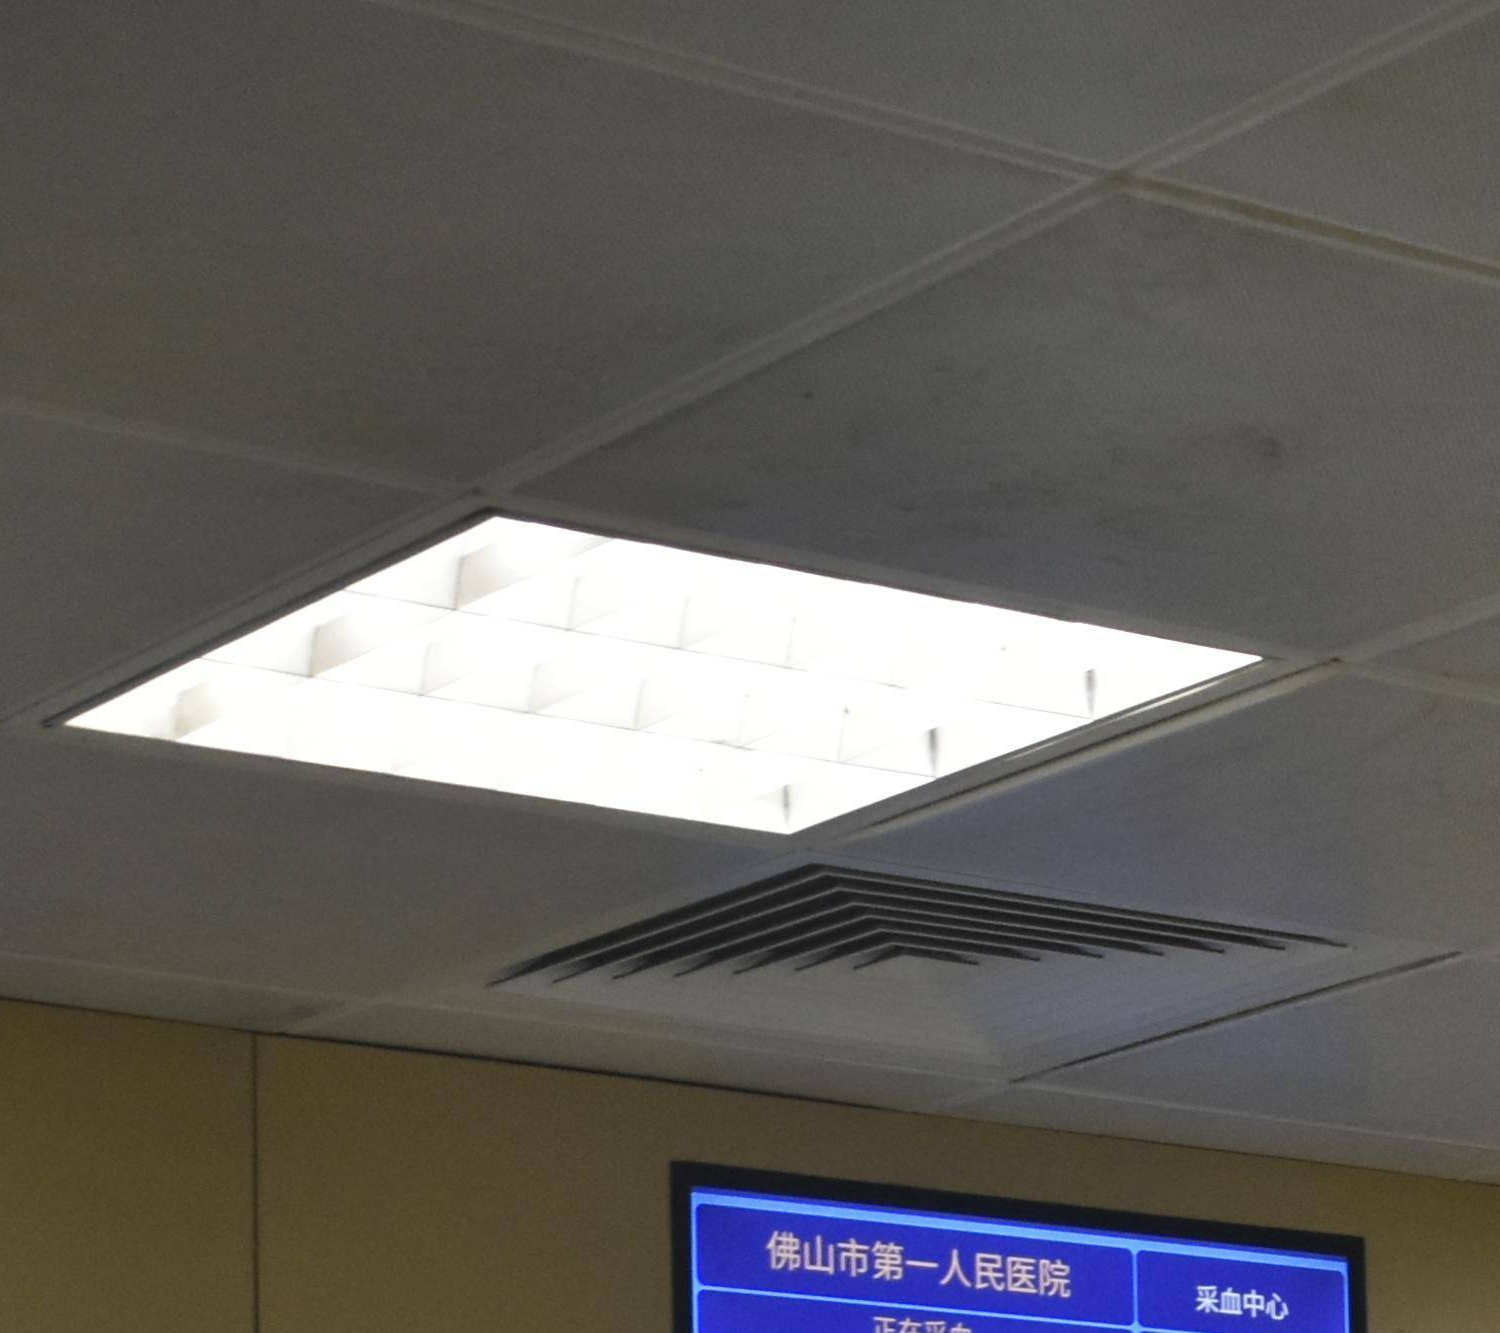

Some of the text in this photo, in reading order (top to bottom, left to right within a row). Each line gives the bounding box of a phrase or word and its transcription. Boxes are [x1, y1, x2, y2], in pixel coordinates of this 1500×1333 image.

[766, 1230, 1072, 1299] 佛山市第一人民医院
[1195, 1284, 1289, 1319] 采血中心
